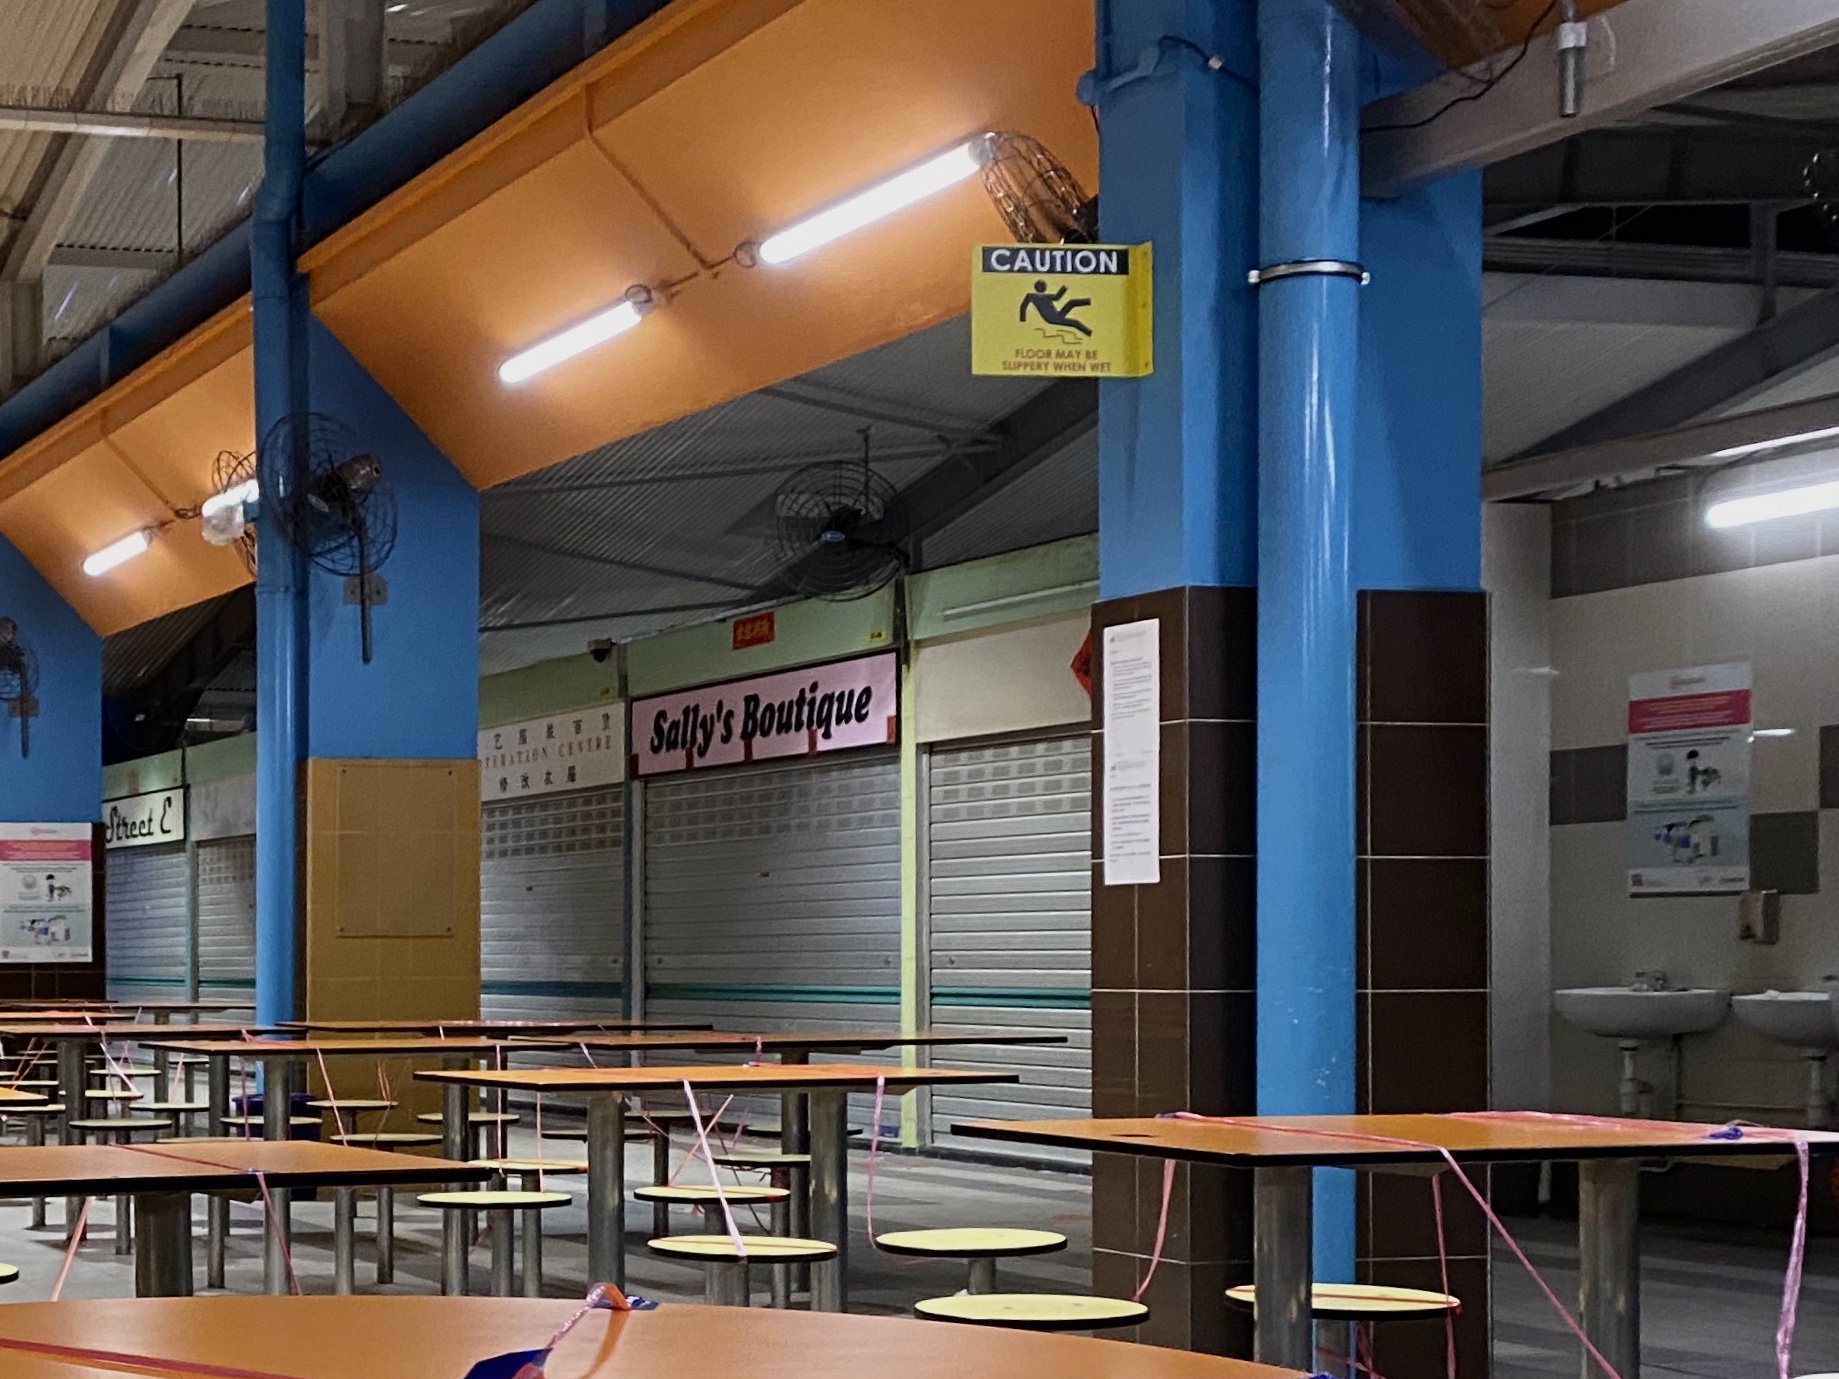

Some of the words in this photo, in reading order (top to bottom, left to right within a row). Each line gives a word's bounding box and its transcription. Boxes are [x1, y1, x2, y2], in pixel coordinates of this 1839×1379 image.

[991, 248, 1118, 273] CAUTION
[1015, 348, 1052, 360] FLOOR
[1055, 349, 1081, 360] MAY
[1085, 349, 1098, 360] BE
[1002, 360, 1050, 372] SLIPPERY
[1053, 361, 1086, 372] WHEN
[1090, 361, 1112, 373] WET
[650, 699, 735, 758] Sally's
[739, 680, 873, 740] Boutique
[557, 734, 612, 758] CENTRE
[105, 804, 154, 844] Street
